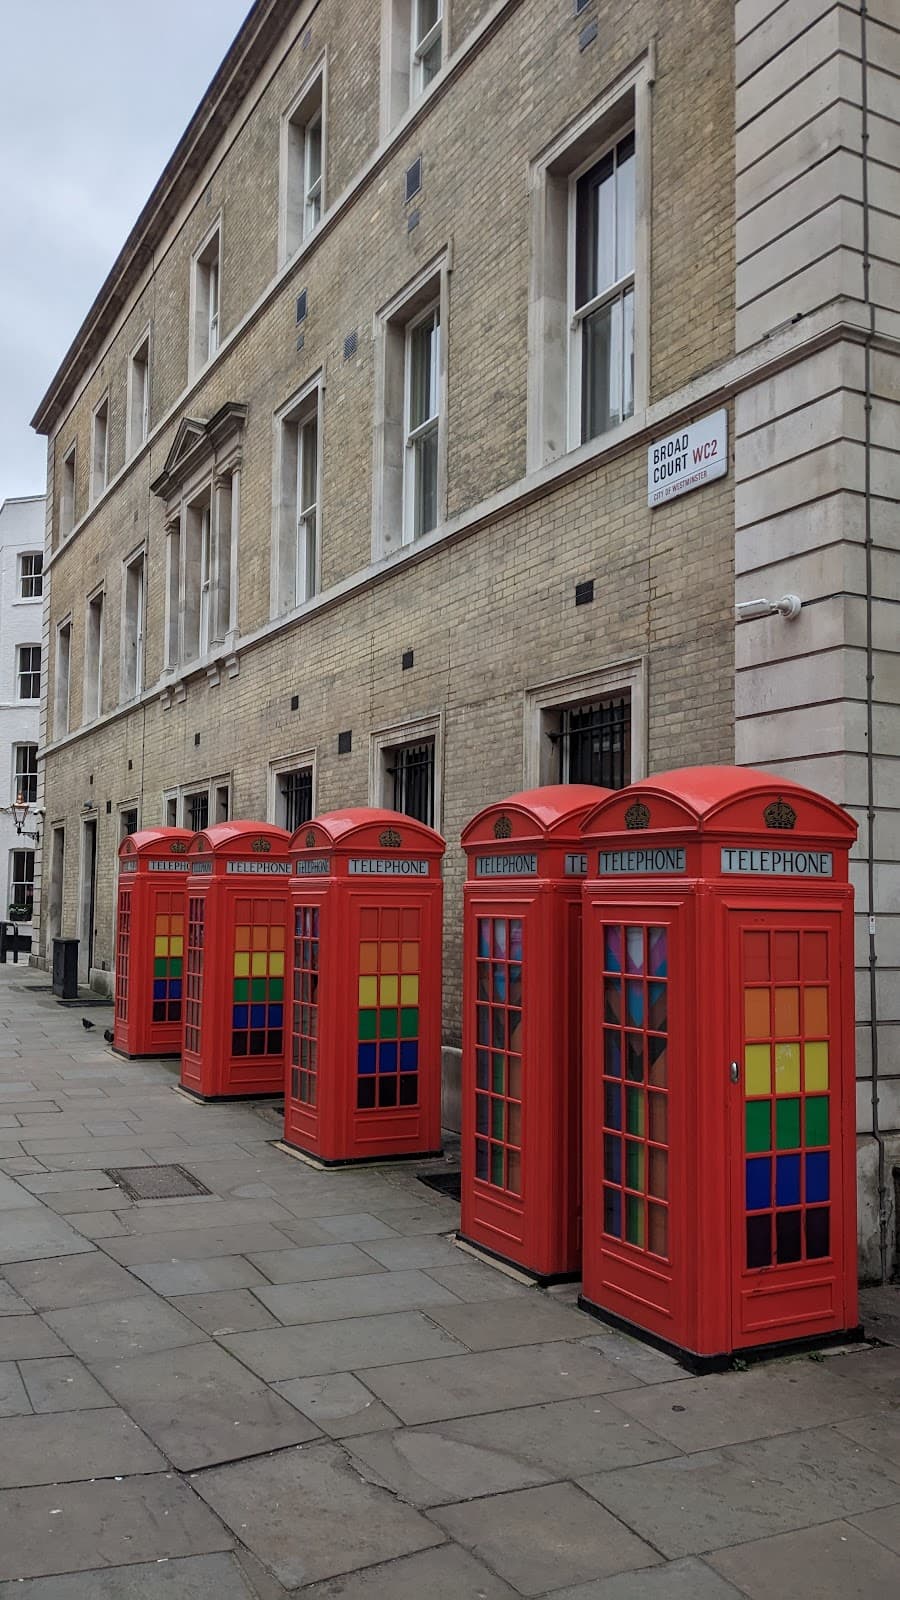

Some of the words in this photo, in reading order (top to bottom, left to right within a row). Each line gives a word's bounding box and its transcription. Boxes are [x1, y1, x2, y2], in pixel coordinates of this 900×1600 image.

[653, 434, 689, 465] BROAD
[653, 453, 688, 483] COURT
[692, 439, 718, 464] WC2
[653, 490, 664, 501] CITY
[665, 485, 673, 496] OF
[672, 470, 708, 491] WESTMINSTER
[152, 861, 190, 871] TELEPH
[228, 861, 291, 873] TELEPHONE
[351, 859, 426, 874] TELEPHONE
[478, 855, 536, 873] TELEPHONE
[602, 849, 684, 872] TELEPHONE
[724, 849, 829, 874] TELEPHONE
